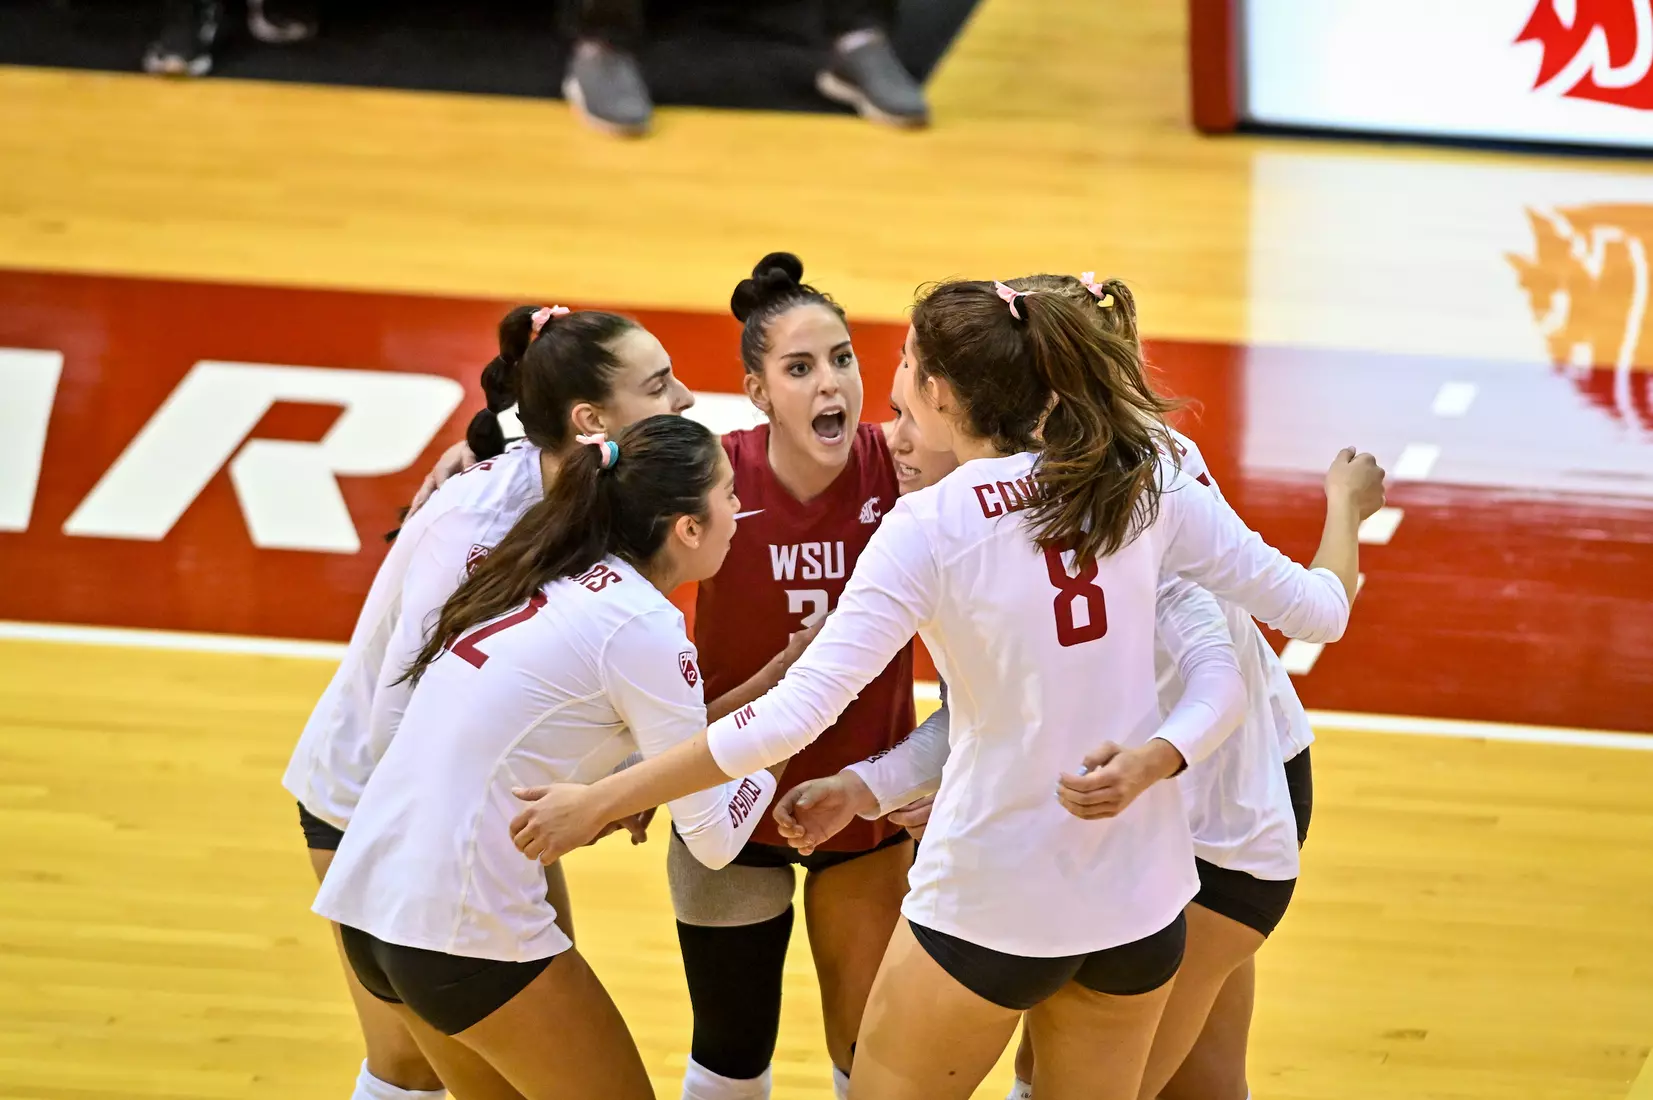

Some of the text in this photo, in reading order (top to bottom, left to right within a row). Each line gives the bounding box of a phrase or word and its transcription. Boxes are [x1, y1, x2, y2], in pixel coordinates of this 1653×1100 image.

[769, 541, 845, 581] WSU
[1036, 531, 1107, 647] 8
[687, 670, 697, 682] 12
